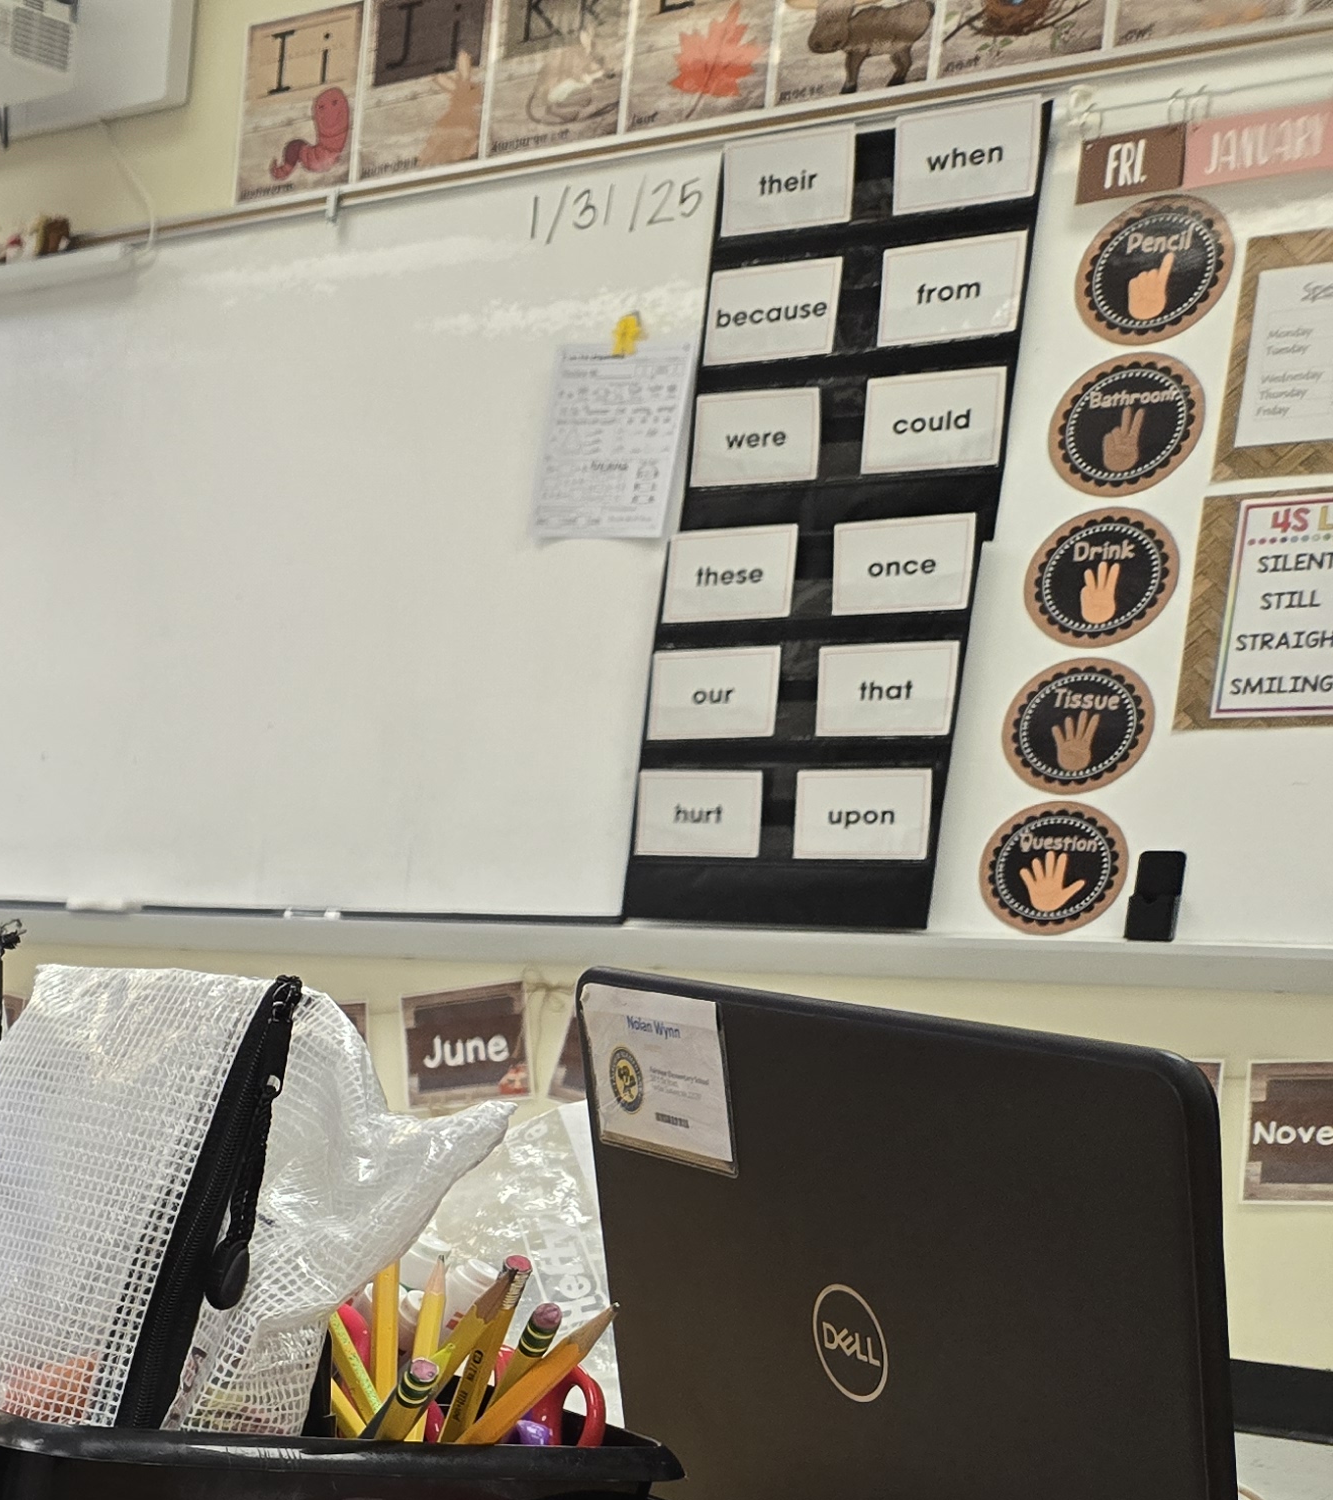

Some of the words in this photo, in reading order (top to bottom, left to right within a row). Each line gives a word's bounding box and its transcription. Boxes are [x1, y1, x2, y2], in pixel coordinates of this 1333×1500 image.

[926, 146, 1003, 174] when
[1103, 138, 1147, 190] FRI.
[759, 169, 818, 197] their
[1125, 223, 1194, 254] Pencil
[916, 281, 981, 306] from
[716, 301, 828, 329] because
[1088, 387, 1181, 410] Bathroom
[892, 408, 972, 436] could
[725, 428, 787, 450] were
[1270, 508, 1310, 533] 4S
[1072, 539, 1137, 563] Drink
[696, 565, 764, 588] these
[867, 556, 937, 577] once
[1259, 590, 1322, 611] STILL
[692, 687, 735, 706] our
[859, 680, 914, 702] that
[1230, 674, 1333, 696] SMILING
[1053, 688, 1121, 711] Tissue
[673, 804, 723, 825] hurt
[827, 808, 896, 830] upon
[1020, 832, 1099, 853] Question
[654, 1020, 681, 1039] Wynn
[423, 1034, 510, 1069] June
[1253, 1120, 1333, 1146] Nove
[821, 1319, 882, 1368] DELL
